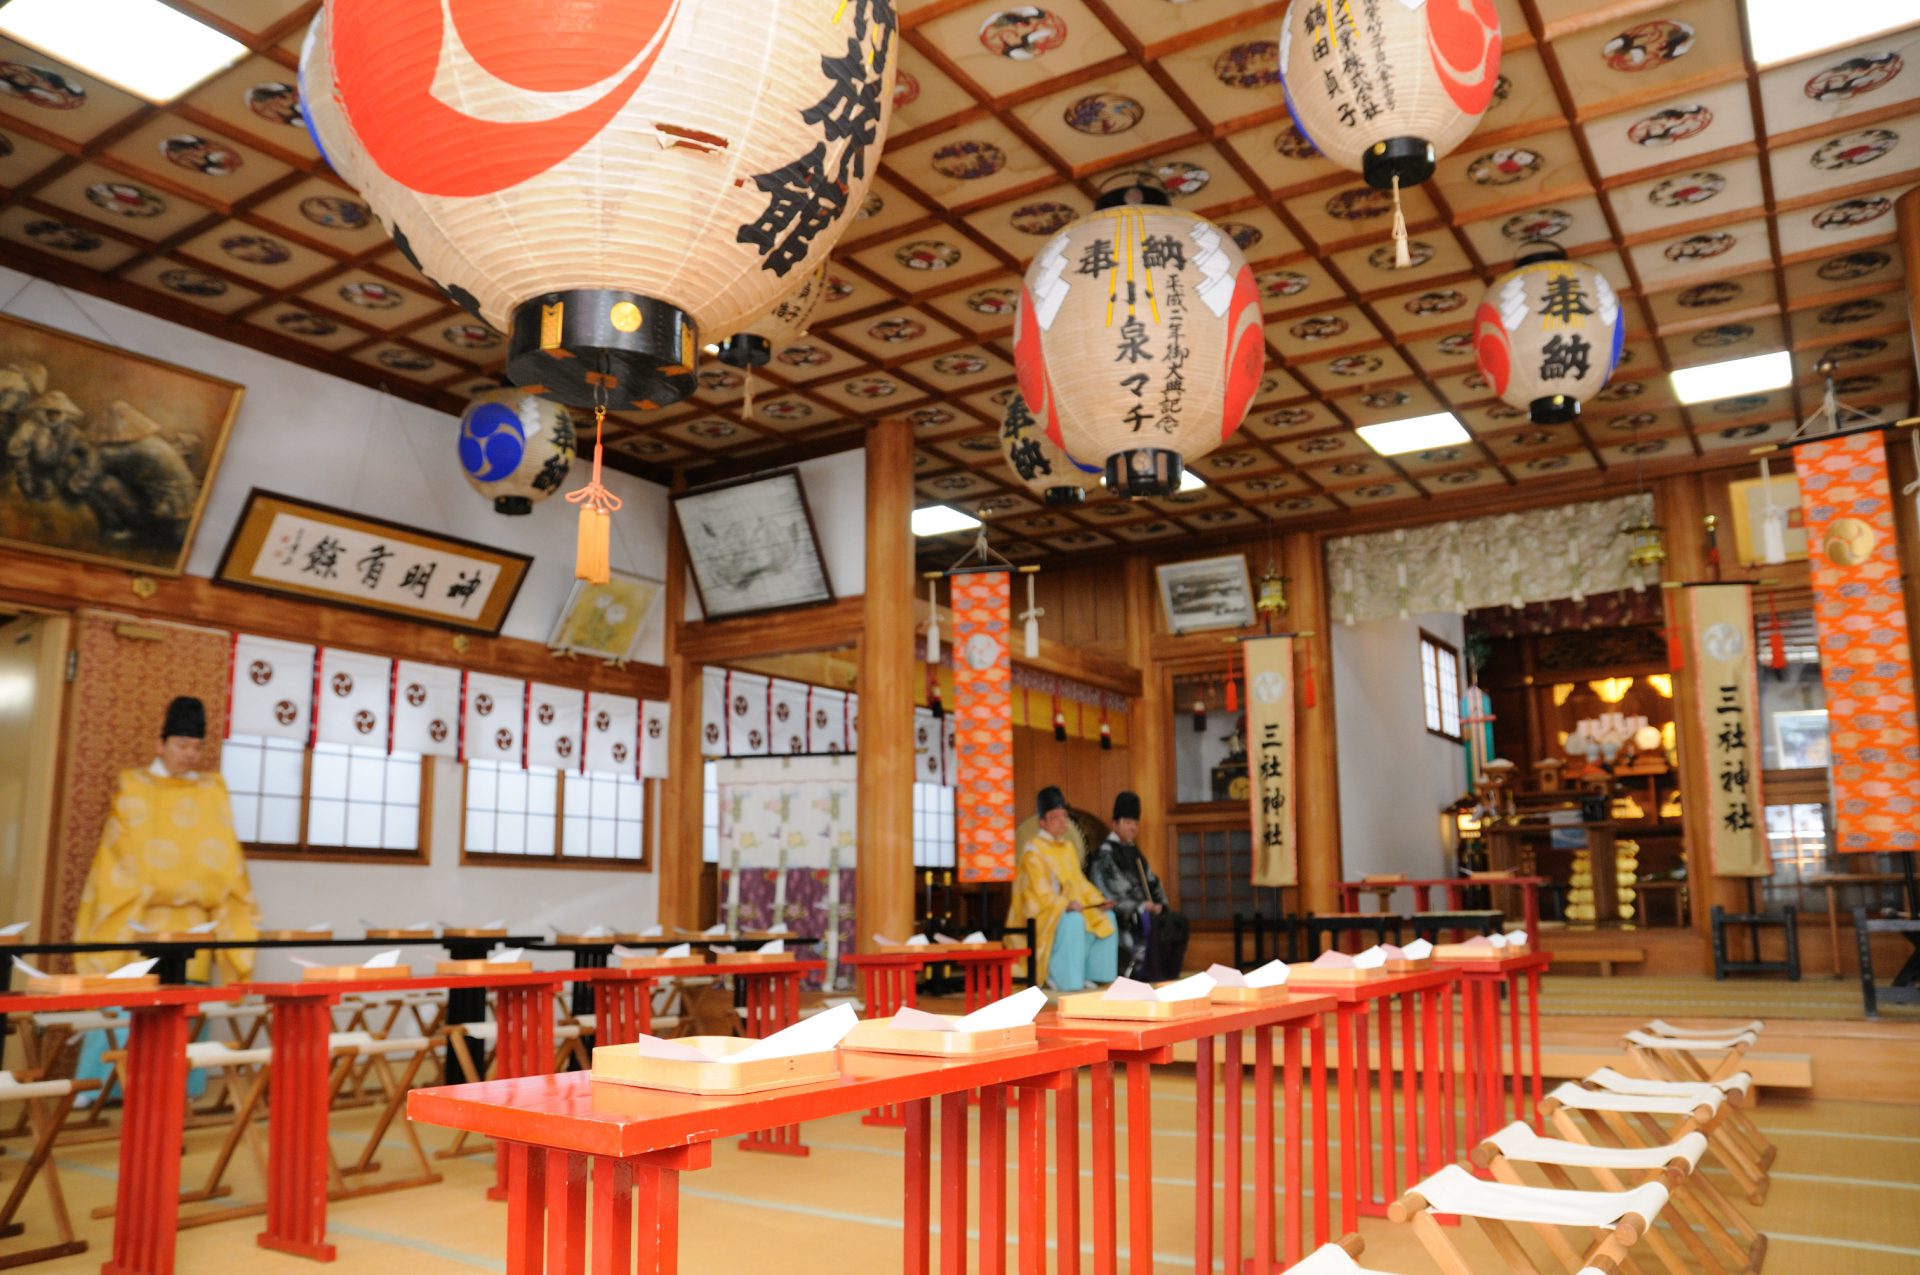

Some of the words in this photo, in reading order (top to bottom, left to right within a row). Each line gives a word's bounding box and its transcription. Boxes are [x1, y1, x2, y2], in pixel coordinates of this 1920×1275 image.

[1075, 235, 1187, 278] 奉納
[1110, 281, 1155, 433] 小泉マチ
[1538, 275, 1594, 380] 奉納
[531, 412, 575, 496] 奉納
[1003, 396, 1051, 480] 奉納
[1260, 724, 1284, 846] 三社神社
[1717, 685, 1754, 832] 三社神社
